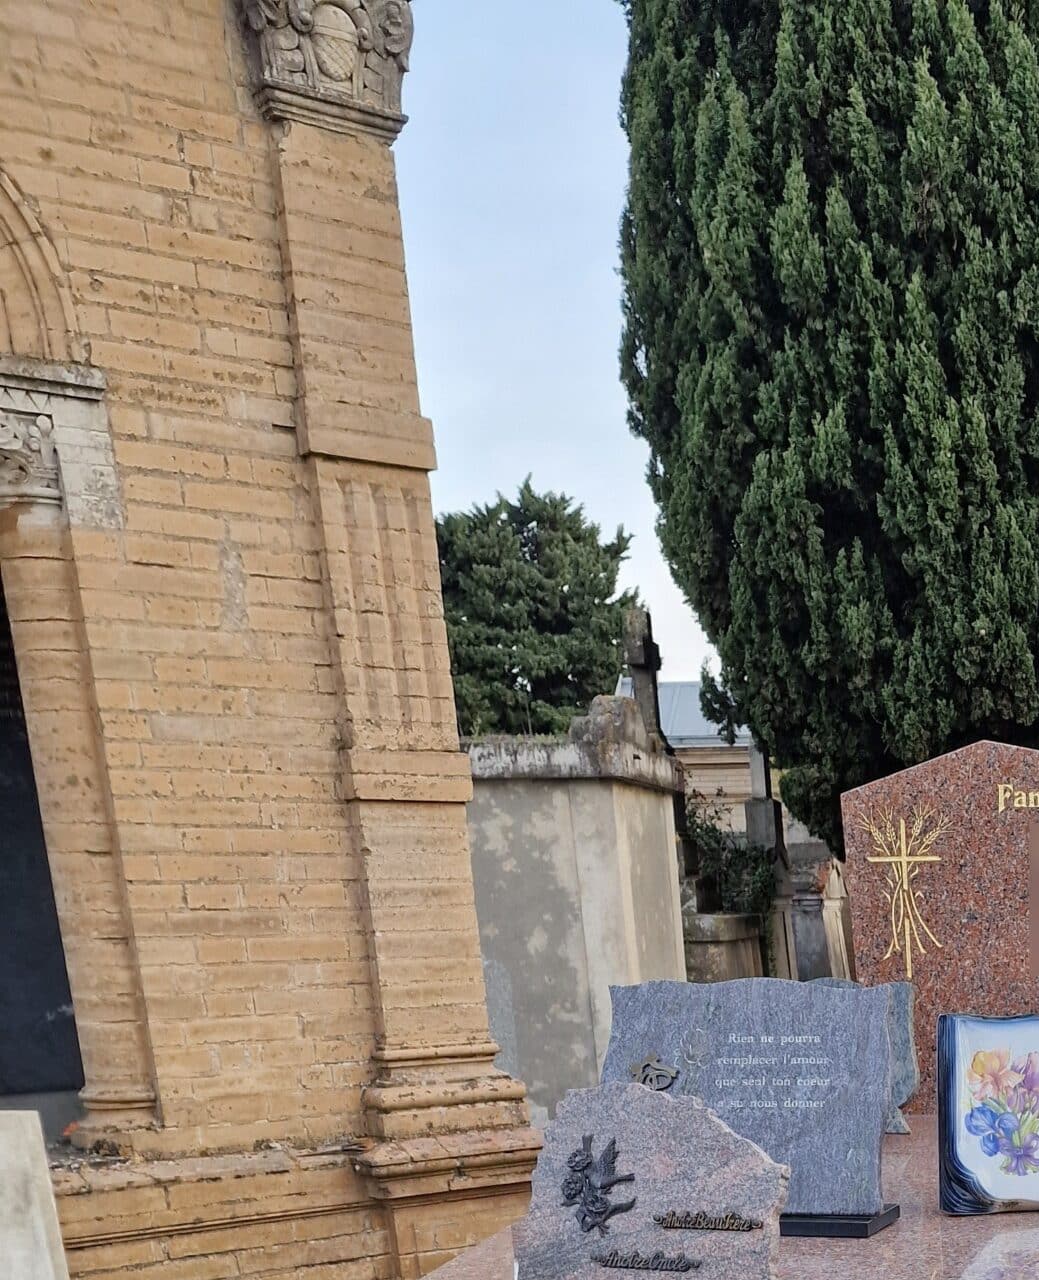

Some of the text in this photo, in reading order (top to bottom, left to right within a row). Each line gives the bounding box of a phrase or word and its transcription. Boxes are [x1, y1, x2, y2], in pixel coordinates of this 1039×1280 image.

[728, 1033, 821, 1046] Rien ne pourra
[717, 1054, 829, 1067] remplacer l'amour
[714, 1078, 736, 1088] que
[772, 1077, 791, 1086] ton
[797, 1077, 830, 1086] coeur
[751, 1099, 777, 1108] nous
[784, 1097, 825, 1108] donner
